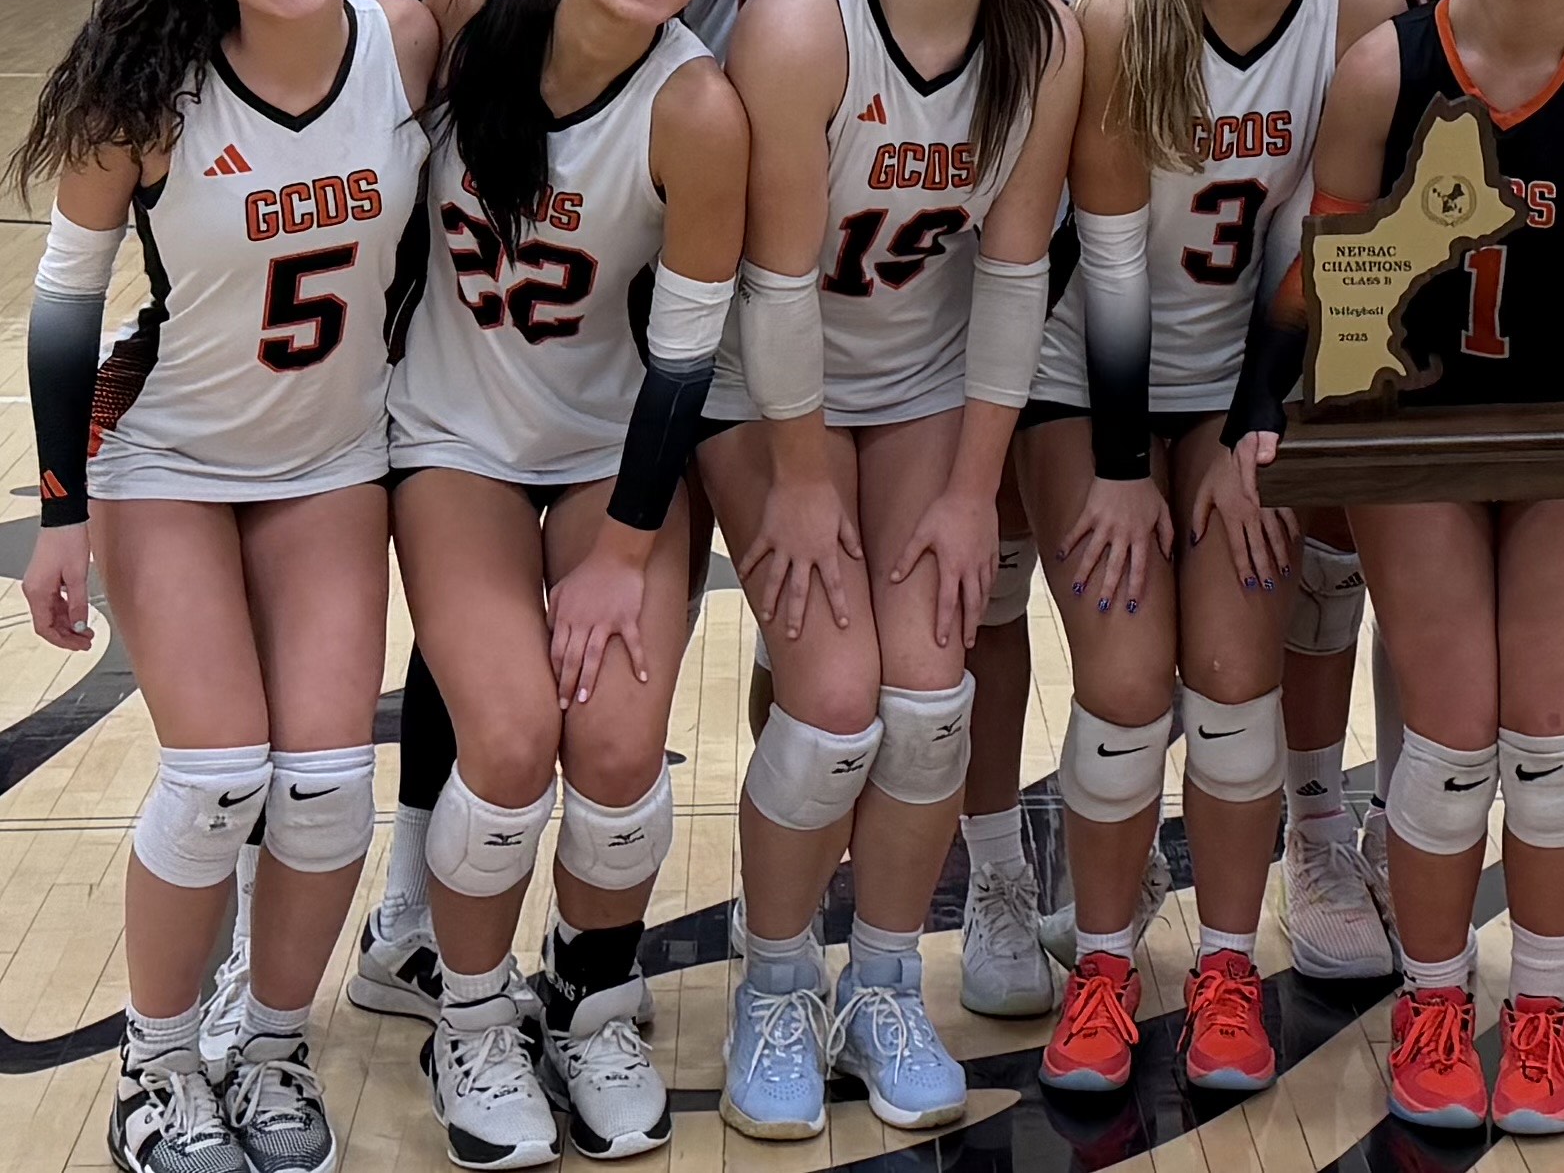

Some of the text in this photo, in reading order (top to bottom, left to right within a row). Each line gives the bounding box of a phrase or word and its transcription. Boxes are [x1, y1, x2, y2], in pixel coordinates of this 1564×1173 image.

[868, 142, 977, 190] GCDS
[1192, 110, 1292, 163] GCDS
[245, 168, 382, 242] GCDS
[1181, 178, 1268, 285] 3
[440, 201, 599, 346] 22
[1322, 261, 1412, 272] CHAMPIONS
[1336, 246, 1397, 258] NEPSAC
[1343, 276, 1381, 286] CLASS
[257, 241, 359, 373] 5
[1461, 245, 1509, 359] 1
